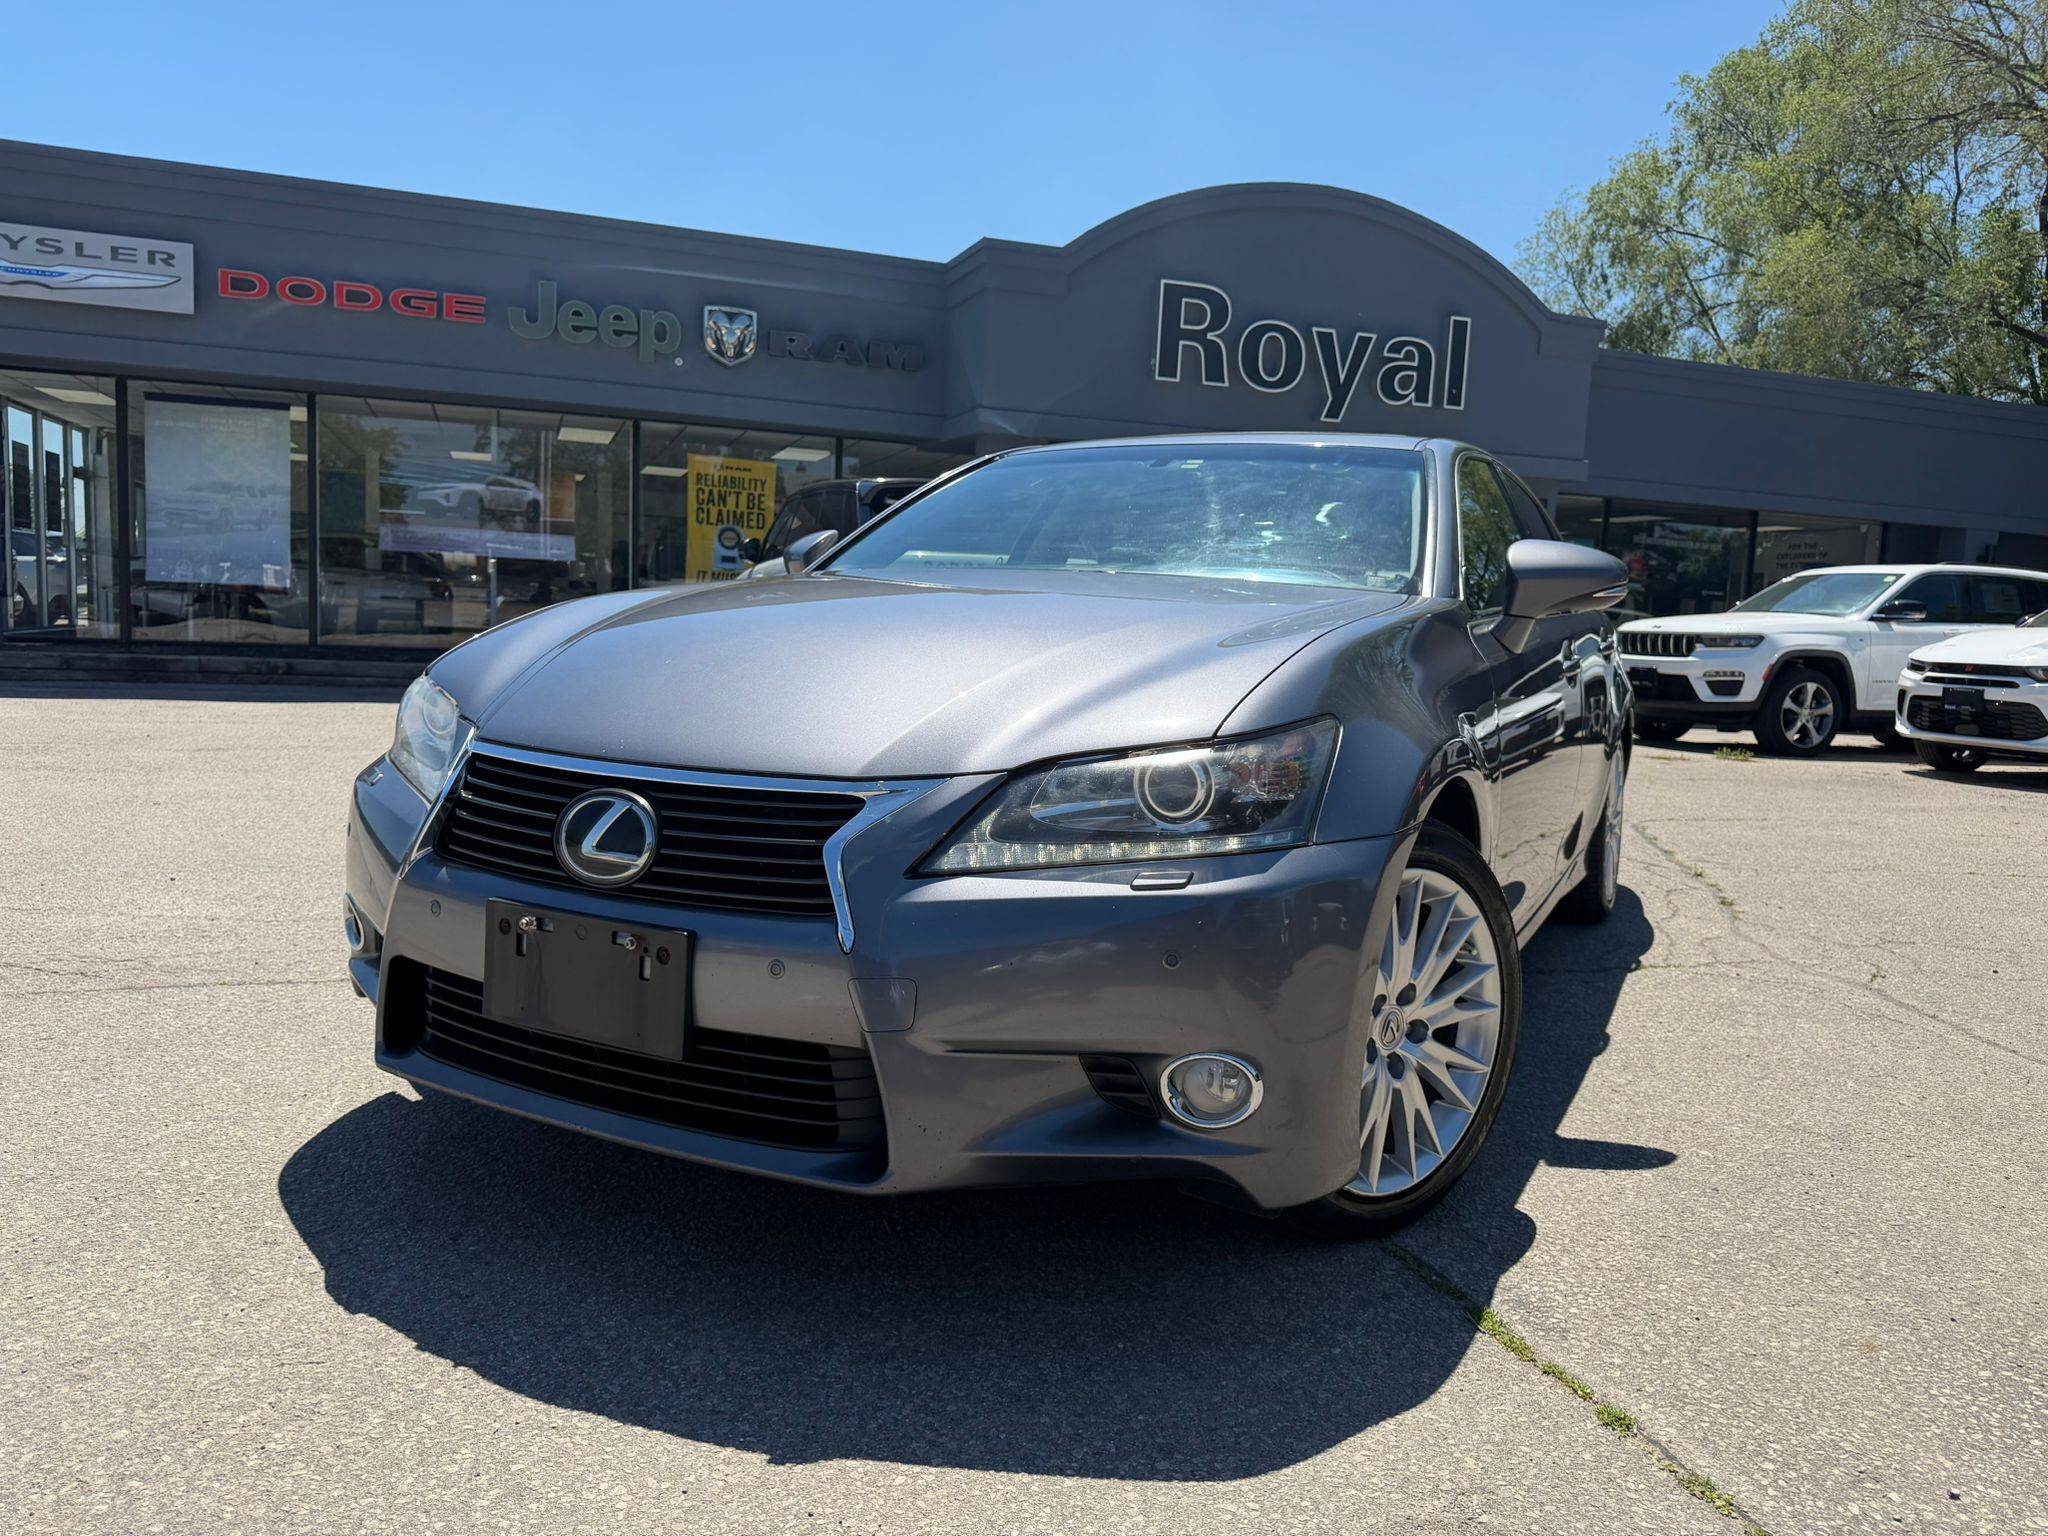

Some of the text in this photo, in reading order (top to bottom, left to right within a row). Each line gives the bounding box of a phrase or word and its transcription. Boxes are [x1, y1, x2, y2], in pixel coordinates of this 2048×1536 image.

[0, 233, 176, 267] YSLER
[217, 267, 487, 324] DODGE
[507, 280, 682, 363] Jeep
[768, 328, 925, 372] RAM
[1154, 278, 1472, 423] Royal
[696, 472, 767, 492] RELIABILITY
[696, 487, 766, 511] CAN'T BE
[696, 507, 766, 530] CLAIMED
[711, 570, 740, 582] MUS
